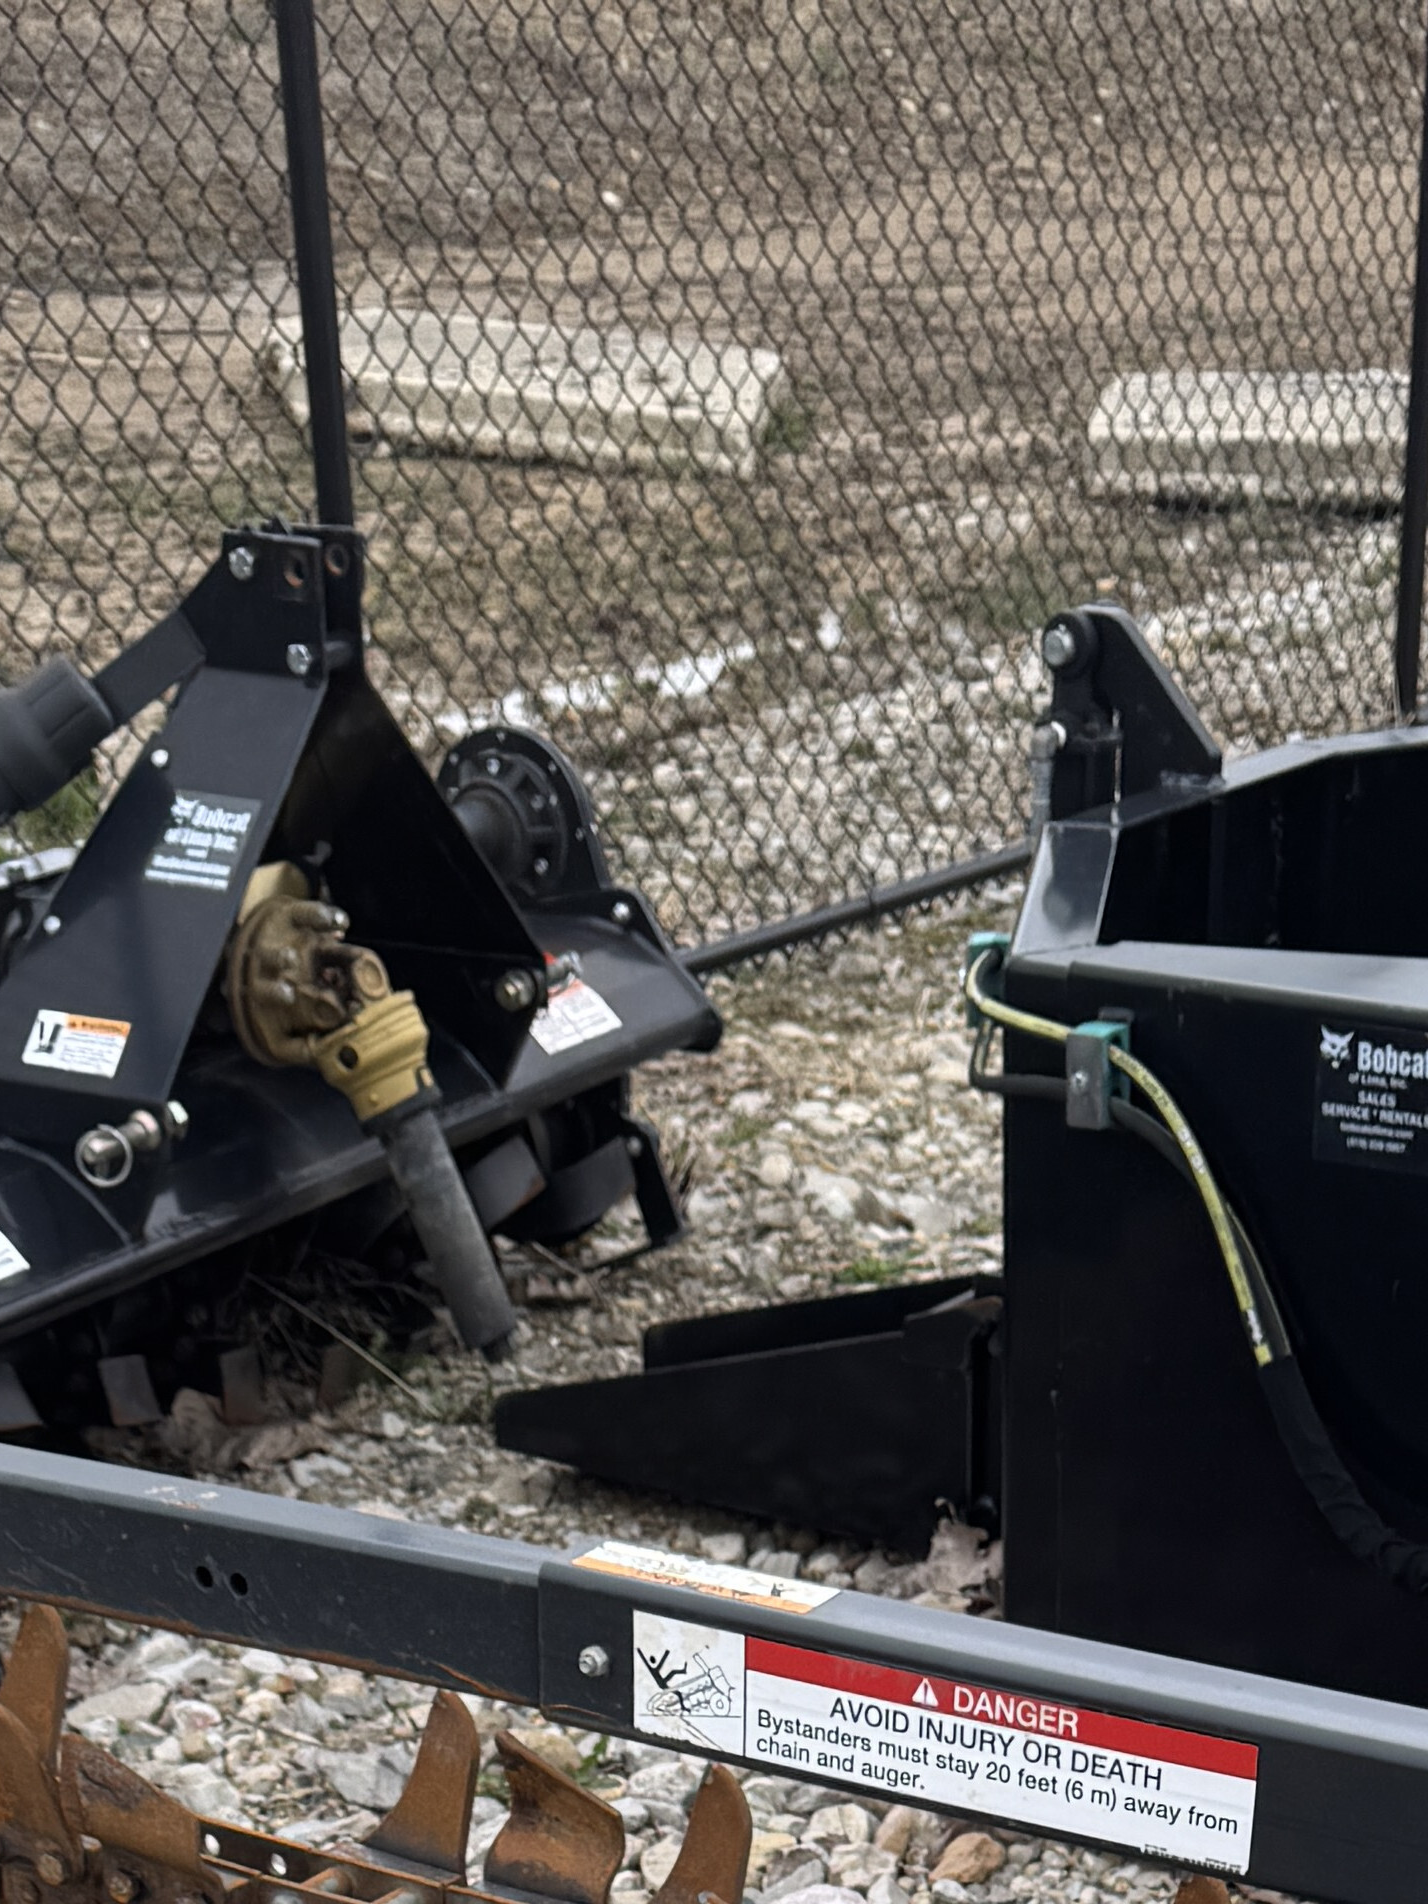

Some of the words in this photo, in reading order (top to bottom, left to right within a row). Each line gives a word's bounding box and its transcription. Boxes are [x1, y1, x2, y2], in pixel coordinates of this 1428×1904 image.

[829, 1697, 910, 1734] AVOID
[918, 1715, 1015, 1757] INJURY
[1022, 1739, 1062, 1769] OR
[1071, 1750, 1162, 1791] DEATH
[953, 1685, 1079, 1738] DANGER
[756, 1736, 811, 1763] chain
[817, 1752, 855, 1773] and
[861, 1761, 926, 1790] auger.
[757, 1708, 872, 1752] Bystanders
[877, 1740, 929, 1766] must
[935, 1753, 980, 1780] stay
[986, 1761, 1011, 1783] 20
[1018, 1768, 1058, 1795] feet
[1065, 1778, 1084, 1803] (6
[1090, 1787, 1117, 1812] m)
[1124, 1796, 1182, 1826] away
[1188, 1806, 1239, 1835] from
